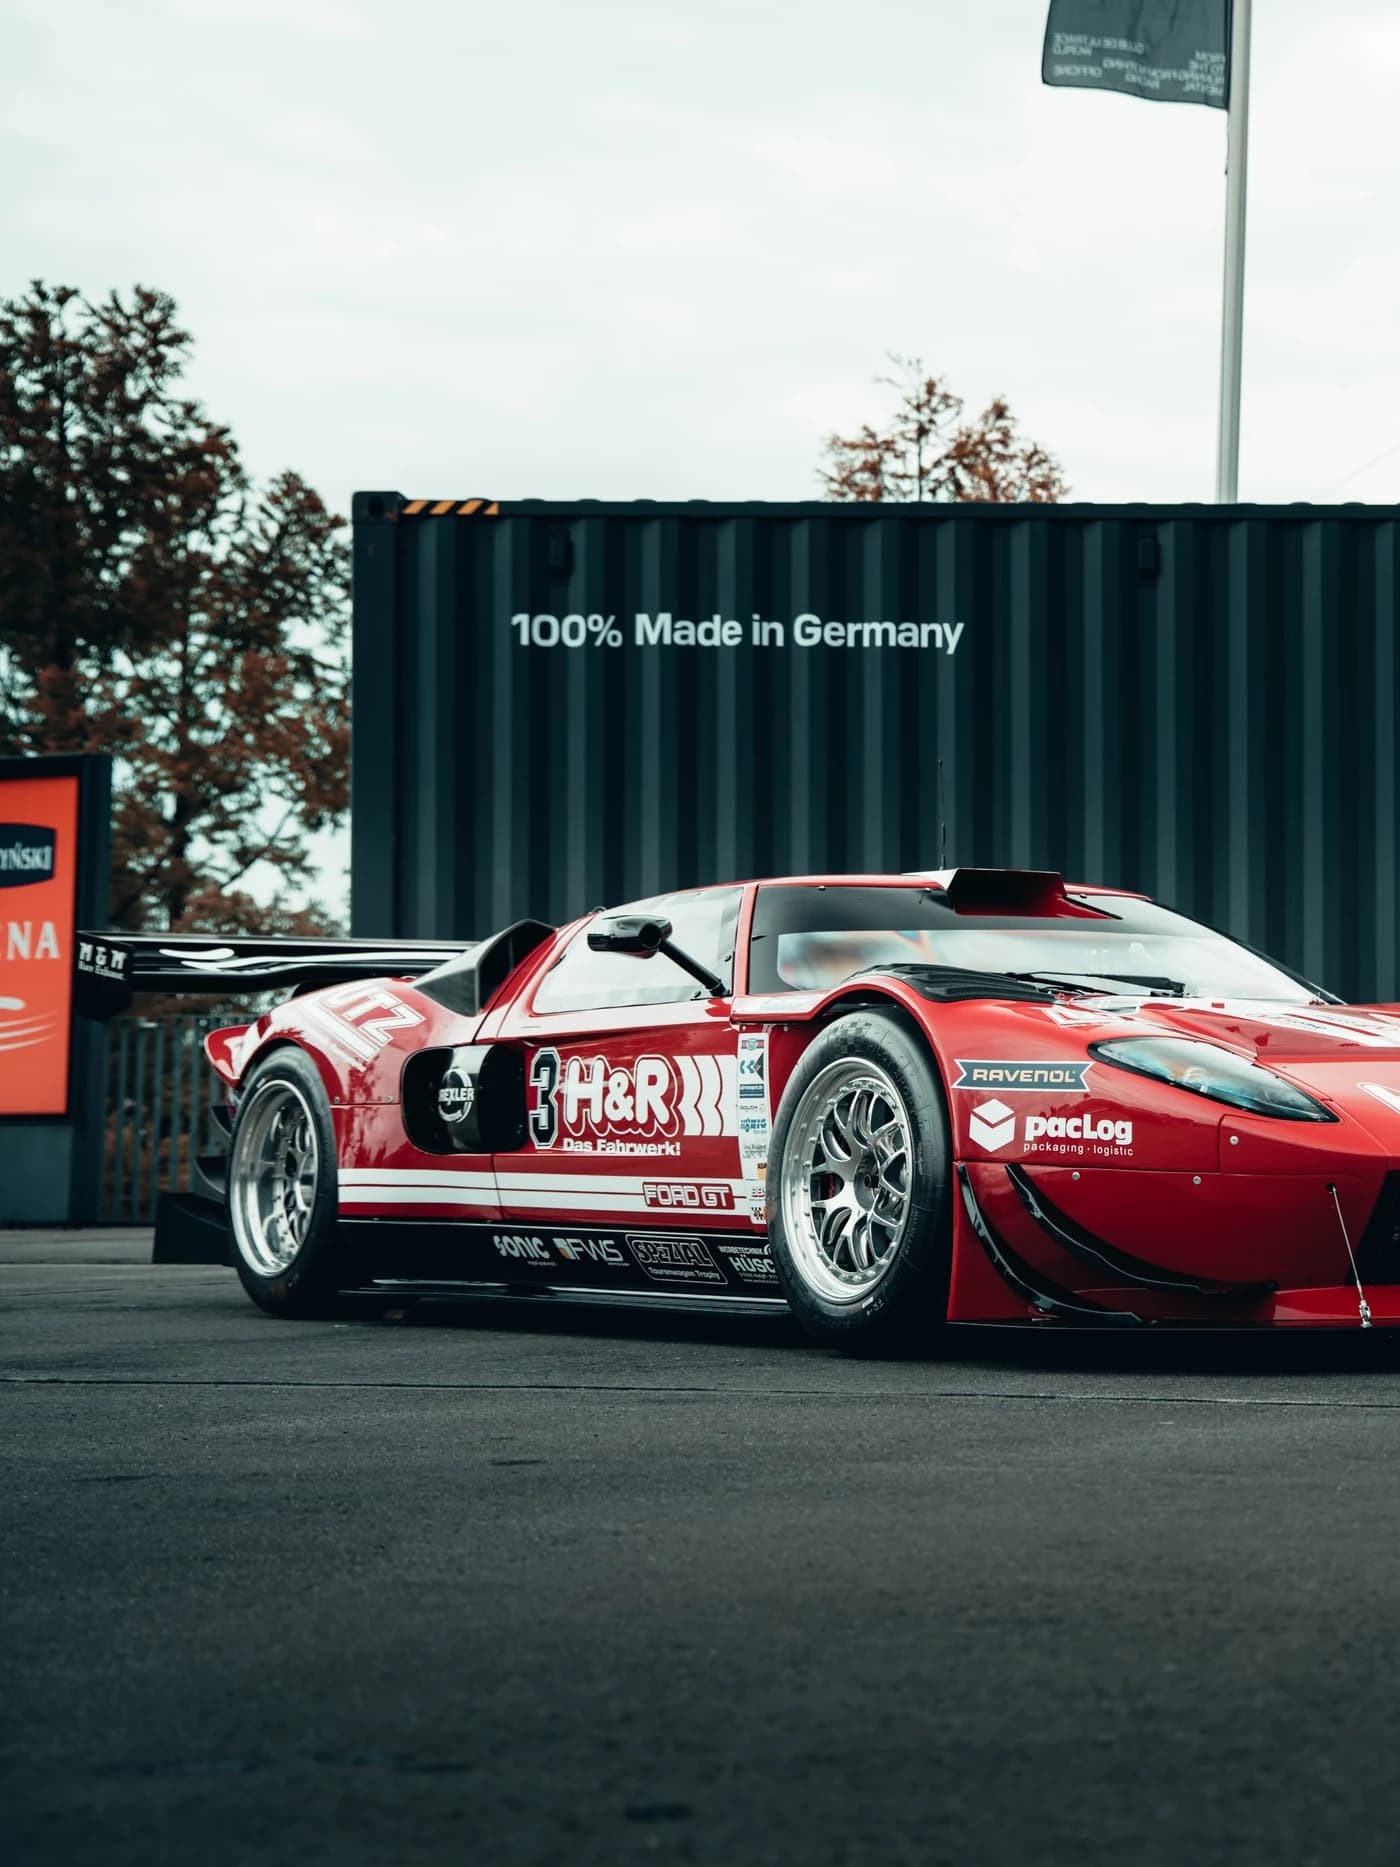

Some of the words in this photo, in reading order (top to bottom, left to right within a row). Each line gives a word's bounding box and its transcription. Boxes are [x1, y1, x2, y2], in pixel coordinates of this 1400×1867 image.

[510, 613, 623, 648] 100%
[634, 613, 742, 647] Made
[752, 613, 784, 647] in
[793, 613, 965, 655] Germany
[972, 1068, 1076, 1083] RAVENOL
[529, 1047, 560, 1149] 3
[564, 1054, 680, 1138] H&R
[1025, 1113, 1133, 1146] pacLog
[562, 1138, 593, 1152] Das
[596, 1138, 681, 1157] Fahrwerk!
[1023, 1141, 1084, 1155] packaging
[1093, 1144, 1134, 1157] logistic
[643, 1184, 700, 1206] FORD
[702, 1186, 730, 1207] GT
[566, 1238, 624, 1262] FWS
[631, 1240, 714, 1267] SPEZIAL
